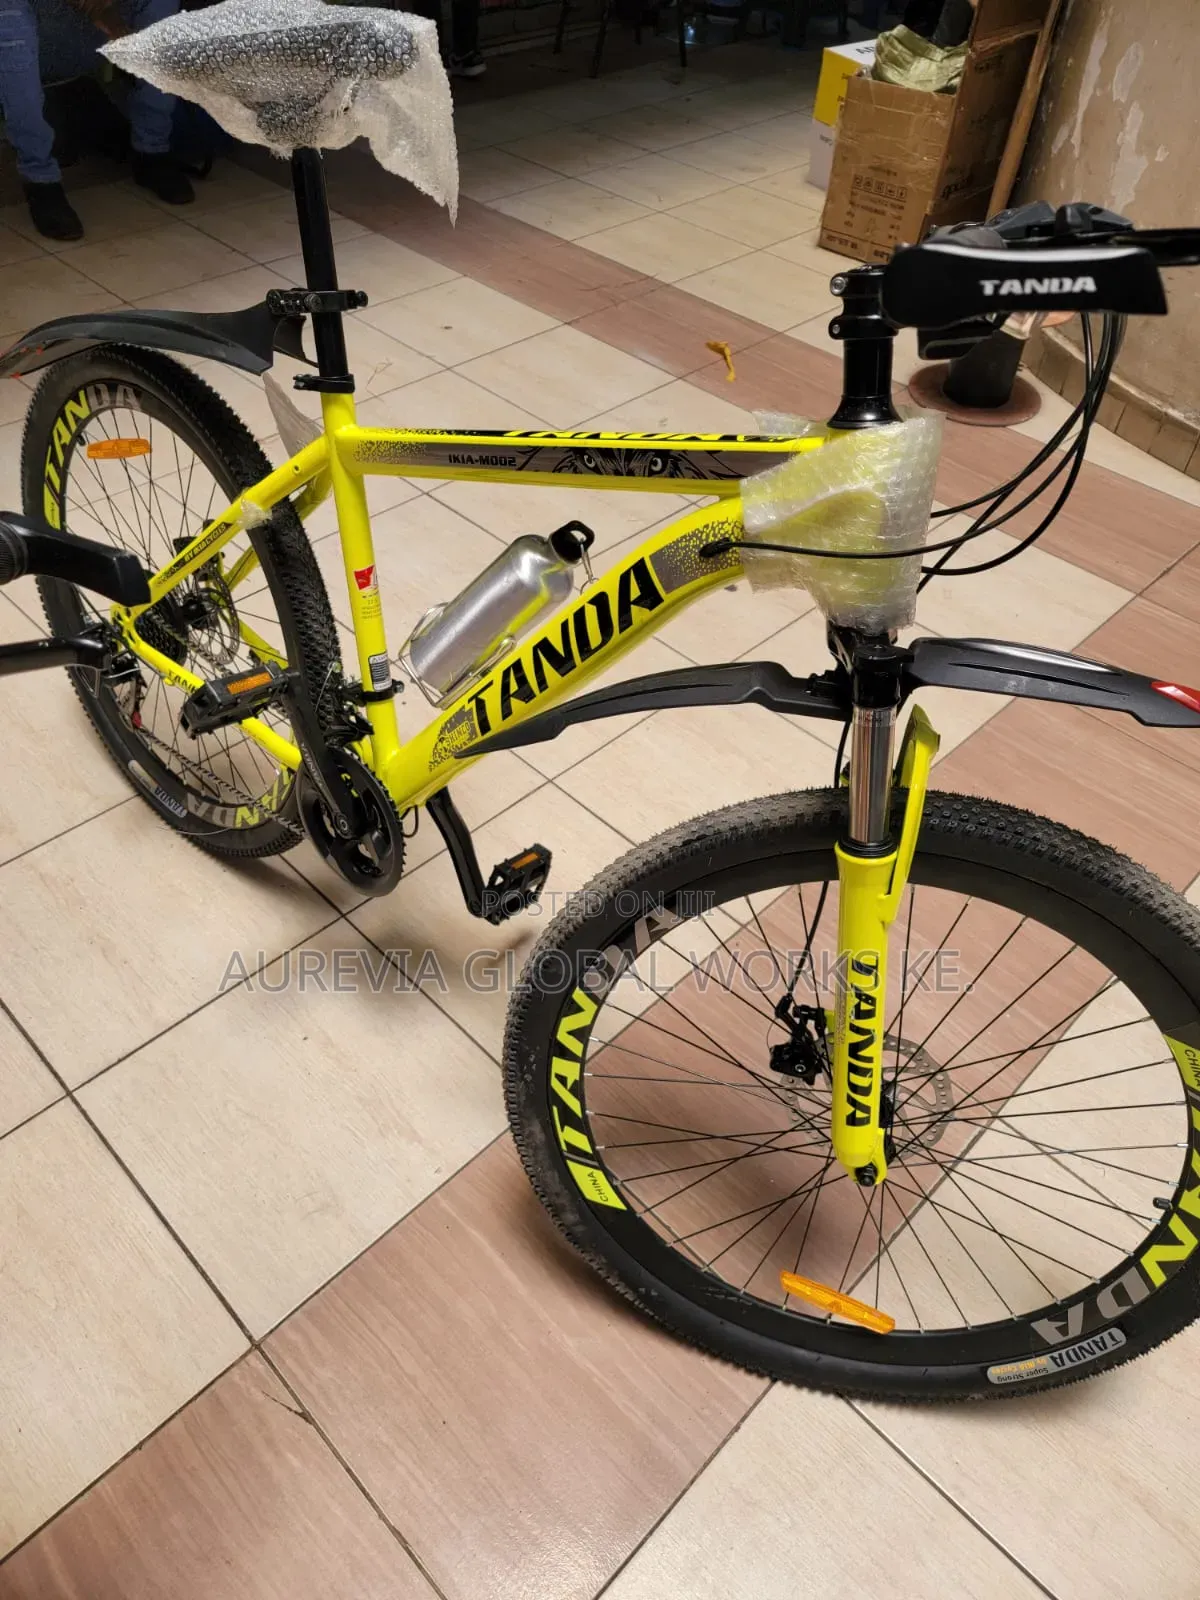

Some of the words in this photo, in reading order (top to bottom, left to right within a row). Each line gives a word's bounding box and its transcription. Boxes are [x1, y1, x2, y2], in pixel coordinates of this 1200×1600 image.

[980, 276, 1097, 296] TANDA
[44, 383, 142, 492] TANDA
[468, 557, 665, 736] TANDA
[846, 955, 880, 1127] TANDA
[587, 1171, 609, 1202] CHINA
[1050, 1331, 1123, 1368] TANDA
[997, 1373, 1024, 1382] Strong
[1026, 1367, 1049, 1378] Super
